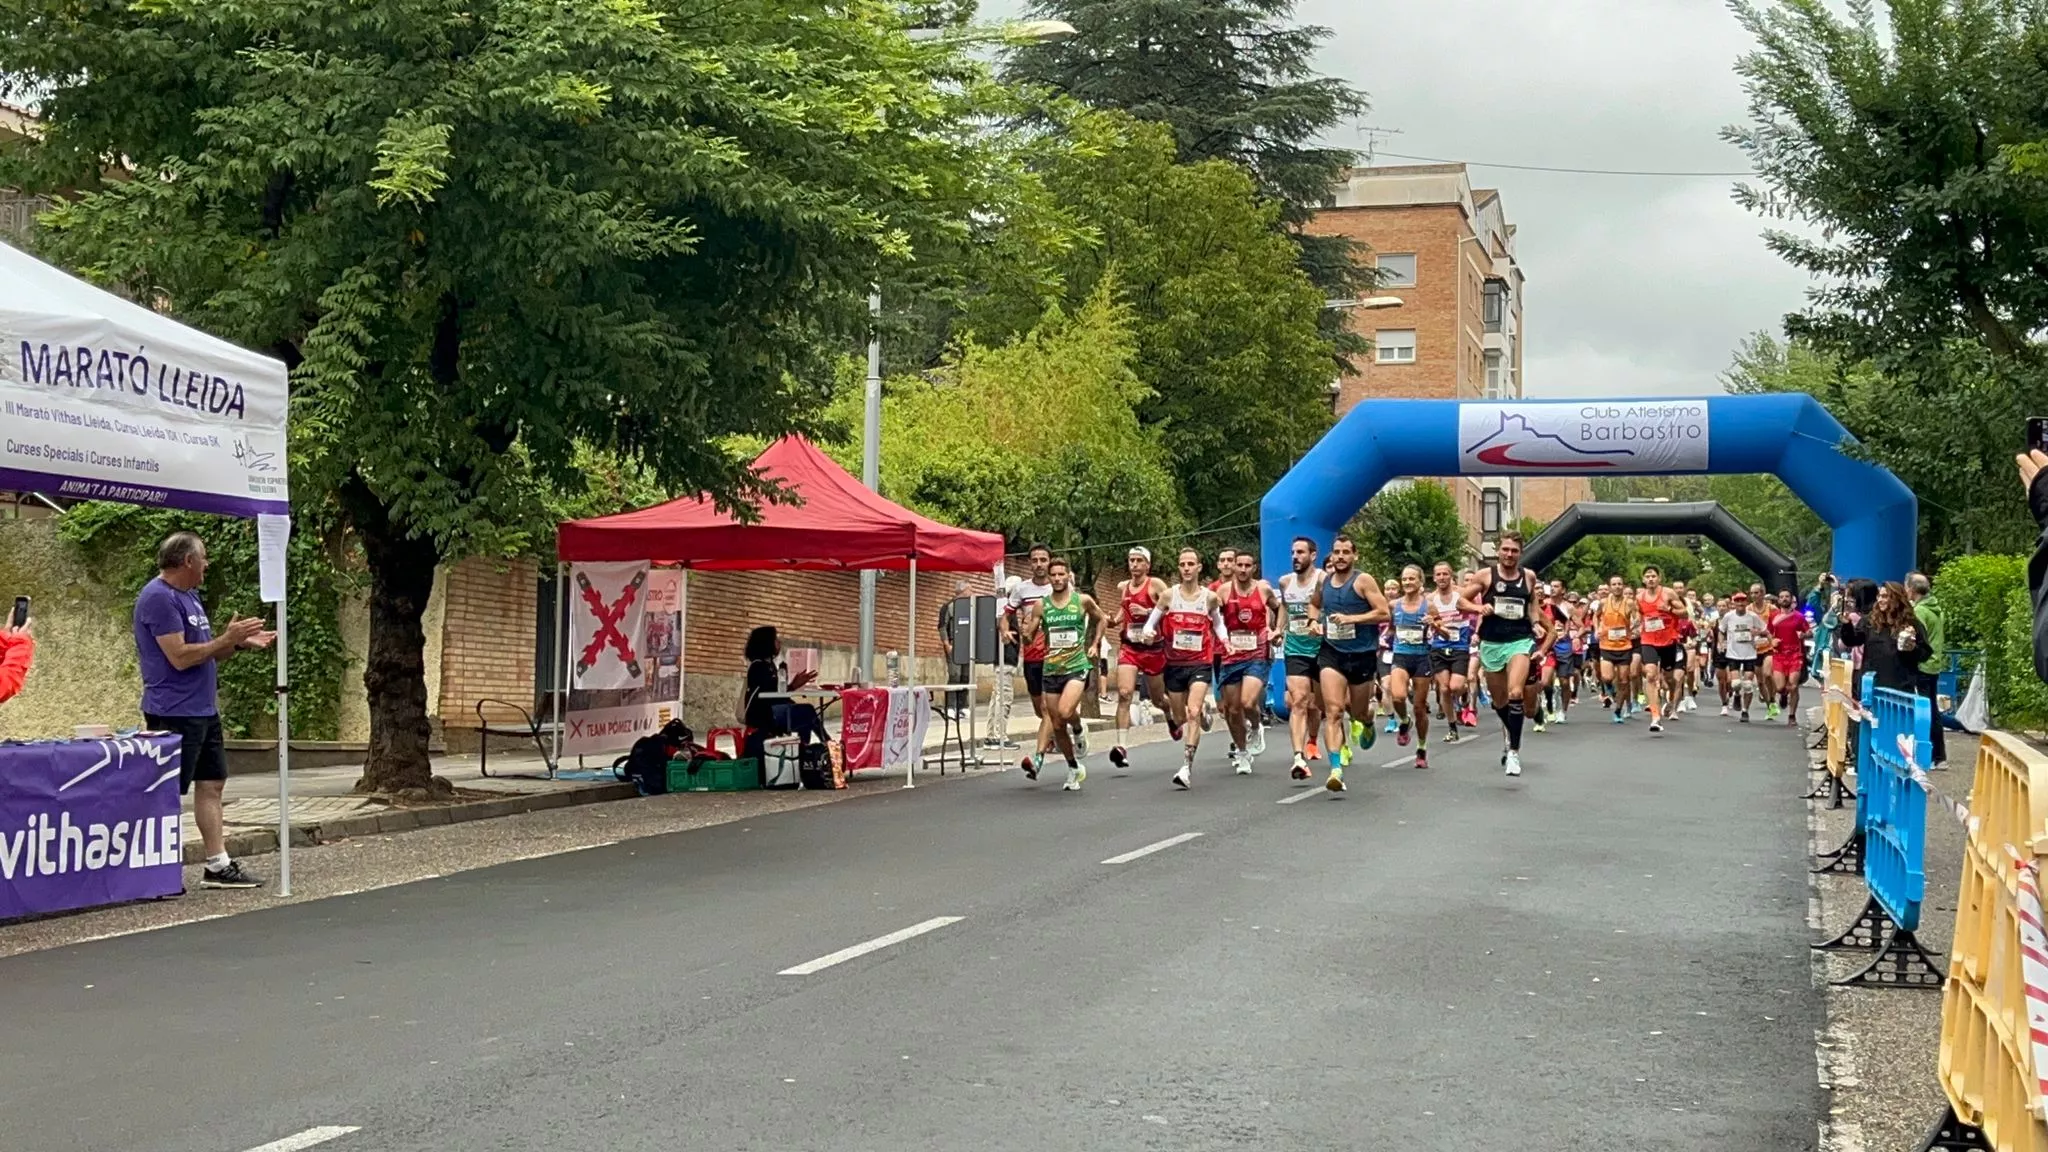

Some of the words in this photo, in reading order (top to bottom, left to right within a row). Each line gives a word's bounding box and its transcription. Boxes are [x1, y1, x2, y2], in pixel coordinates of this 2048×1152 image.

[21, 341, 149, 395] MARATÓ
[158, 363, 245, 420] LLEIDA
[1580, 406, 1621, 419] Club
[1625, 405, 1701, 419] Atletismo
[5, 400, 14, 415] III
[16, 402, 50, 421] Marató
[51, 408, 82, 426] Vithas
[114, 420, 138, 436] Cursa
[183, 432, 208, 447] Cursa
[1580, 422, 1701, 441] Barbastro
[6, 438, 42, 457] Curses
[43, 443, 84, 464] Specials
[90, 452, 122, 468] Curses
[123, 456, 160, 473] Infantils
[98, 484, 107, 496] A
[107, 485, 168, 504] PARTICIPAR!!
[587, 722, 607, 738] TEAM
